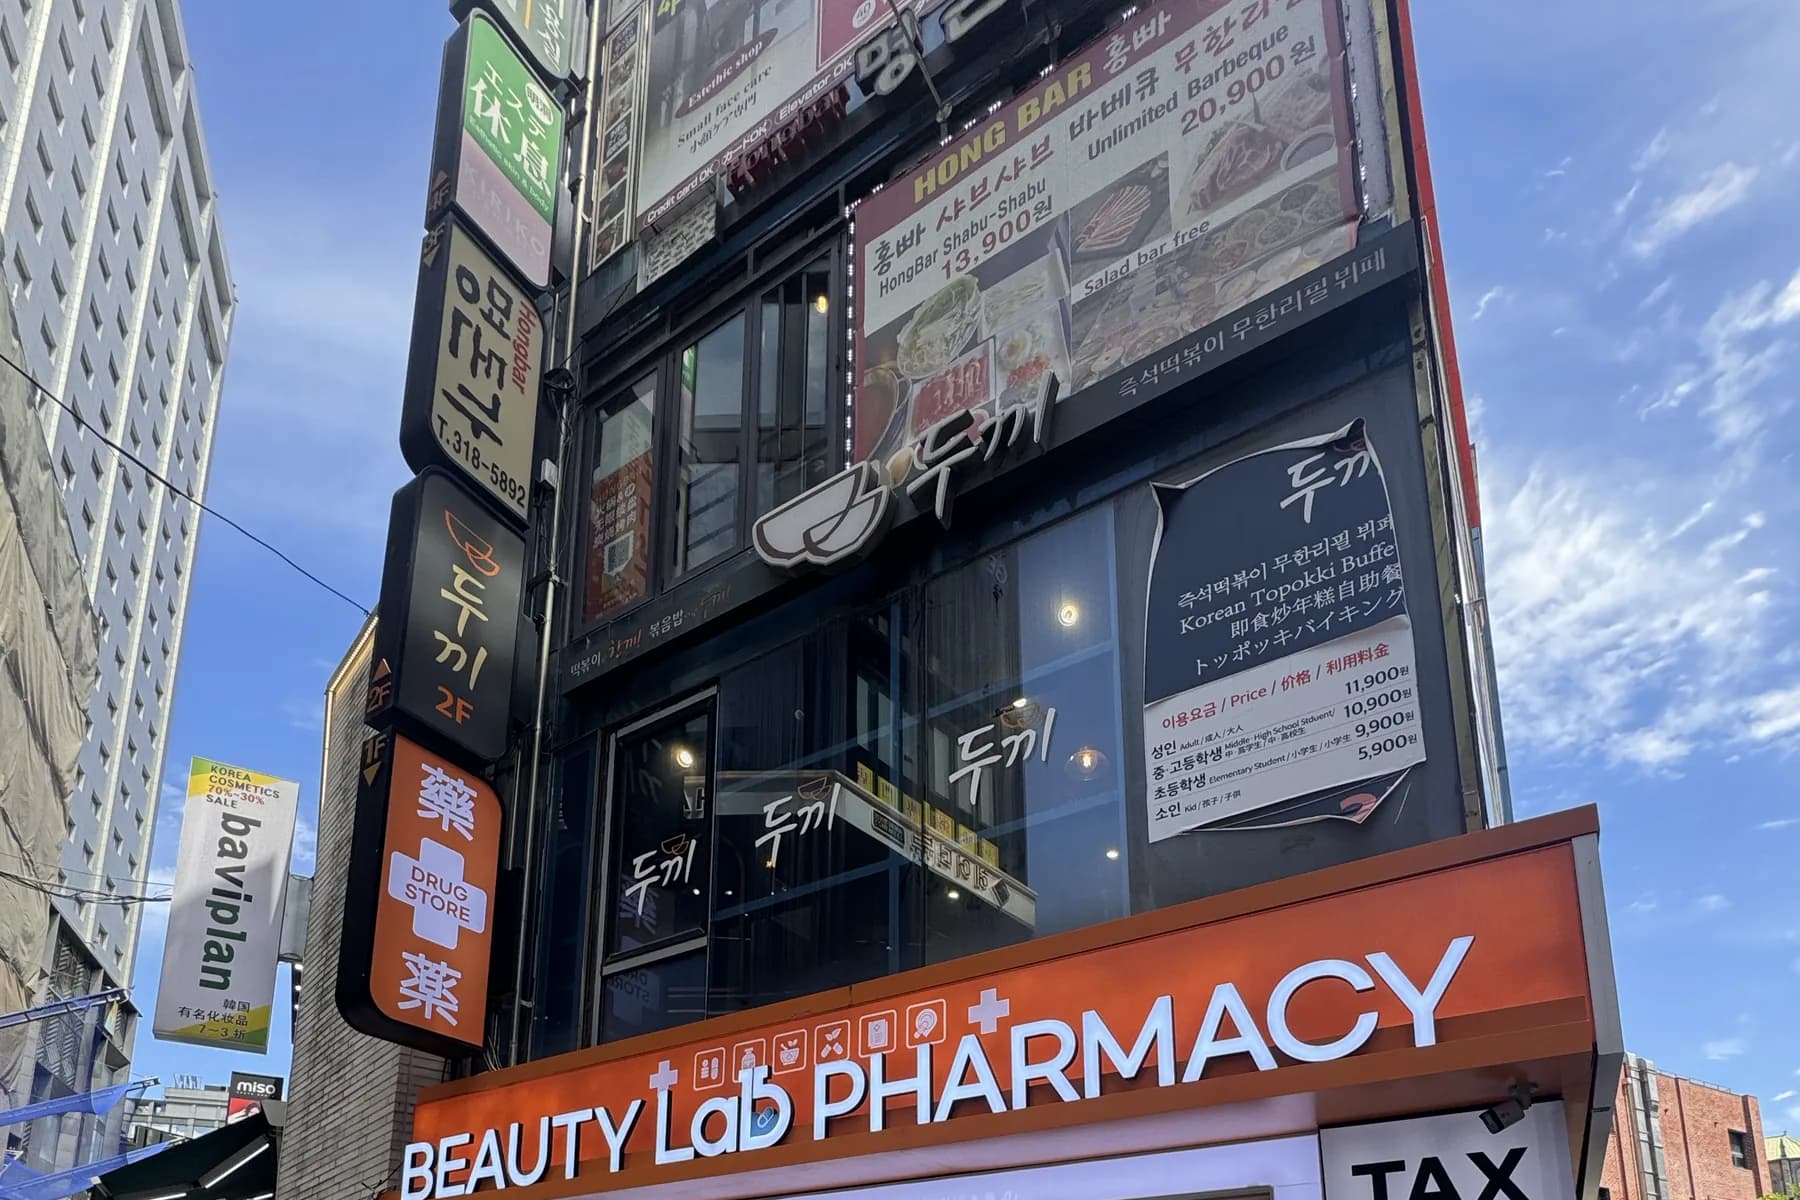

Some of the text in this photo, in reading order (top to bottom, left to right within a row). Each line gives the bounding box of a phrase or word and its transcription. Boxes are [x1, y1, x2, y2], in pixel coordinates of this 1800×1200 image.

[688, 41, 763, 107] Estethic shop
[1174, 0, 1301, 75] 무한리
[483, 60, 547, 140] エステ
[678, 64, 772, 147] Small face care
[779, 56, 854, 120] Elevator OK
[914, 10, 1171, 203] HONG BAR 홍빠
[1088, 24, 1289, 160] Unlimited Barbeque
[470, 77, 552, 198] 休息
[647, 163, 715, 222] Credit card OK
[873, 135, 1053, 275] 홍빠 샤브샤브
[880, 178, 1046, 297] HongBar Shabu-Shabu
[942, 195, 1053, 280] 13,900원
[1084, 220, 1211, 297] Salad bar free
[512, 301, 536, 396] Hongbar
[1118, 248, 1386, 398] 즉석떡볶이 무한리필 뷔페
[437, 414, 527, 509] T.318-5892
[906, 368, 1060, 521] 두끼
[1177, 562, 1267, 611] 즉석떡볶이
[1272, 530, 1349, 573] 무한리필
[1180, 541, 1396, 635] Korean Topokki Buffe
[1230, 563, 1402, 639] 即食炒年糕自助餐
[434, 563, 489, 692] 두끼
[570, 609, 684, 677] 떡볶이 볶음밥
[435, 685, 474, 724] 2F
[1152, 740, 1176, 760] 성인
[1180, 735, 1200, 751] Adult
[1227, 724, 1244, 736] 大人
[1345, 665, 1409, 695] 11,900원
[1162, 643, 1390, 729] 이용요금 Price 价格 利用料金
[211, 765, 251, 782] KOREA
[949, 707, 1057, 806] 두끼
[1153, 688, 1412, 780] 중·고등학생 Middle High School 10,900원
[1154, 710, 1415, 800] 초등학생 Elementary Student 小学生 小学生 9,900원
[206, 794, 238, 809] SALE
[209, 775, 280, 799] COSMETICS
[417, 763, 478, 842] 藥
[1155, 802, 1181, 822] 소인
[1184, 803, 1197, 814] Kid
[1358, 733, 1418, 761] 5,900원
[756, 783, 841, 868] 두끼
[199, 811, 261, 992] baviplan
[404, 883, 471, 922] STORE
[411, 865, 468, 901] DRUG
[625, 839, 697, 917] 두끼
[397, 951, 462, 1027] 薬
[236, 1080, 276, 1094] miso
[655, 1065, 795, 1165] Lab
[813, 935, 1475, 1141] PHARMACY
